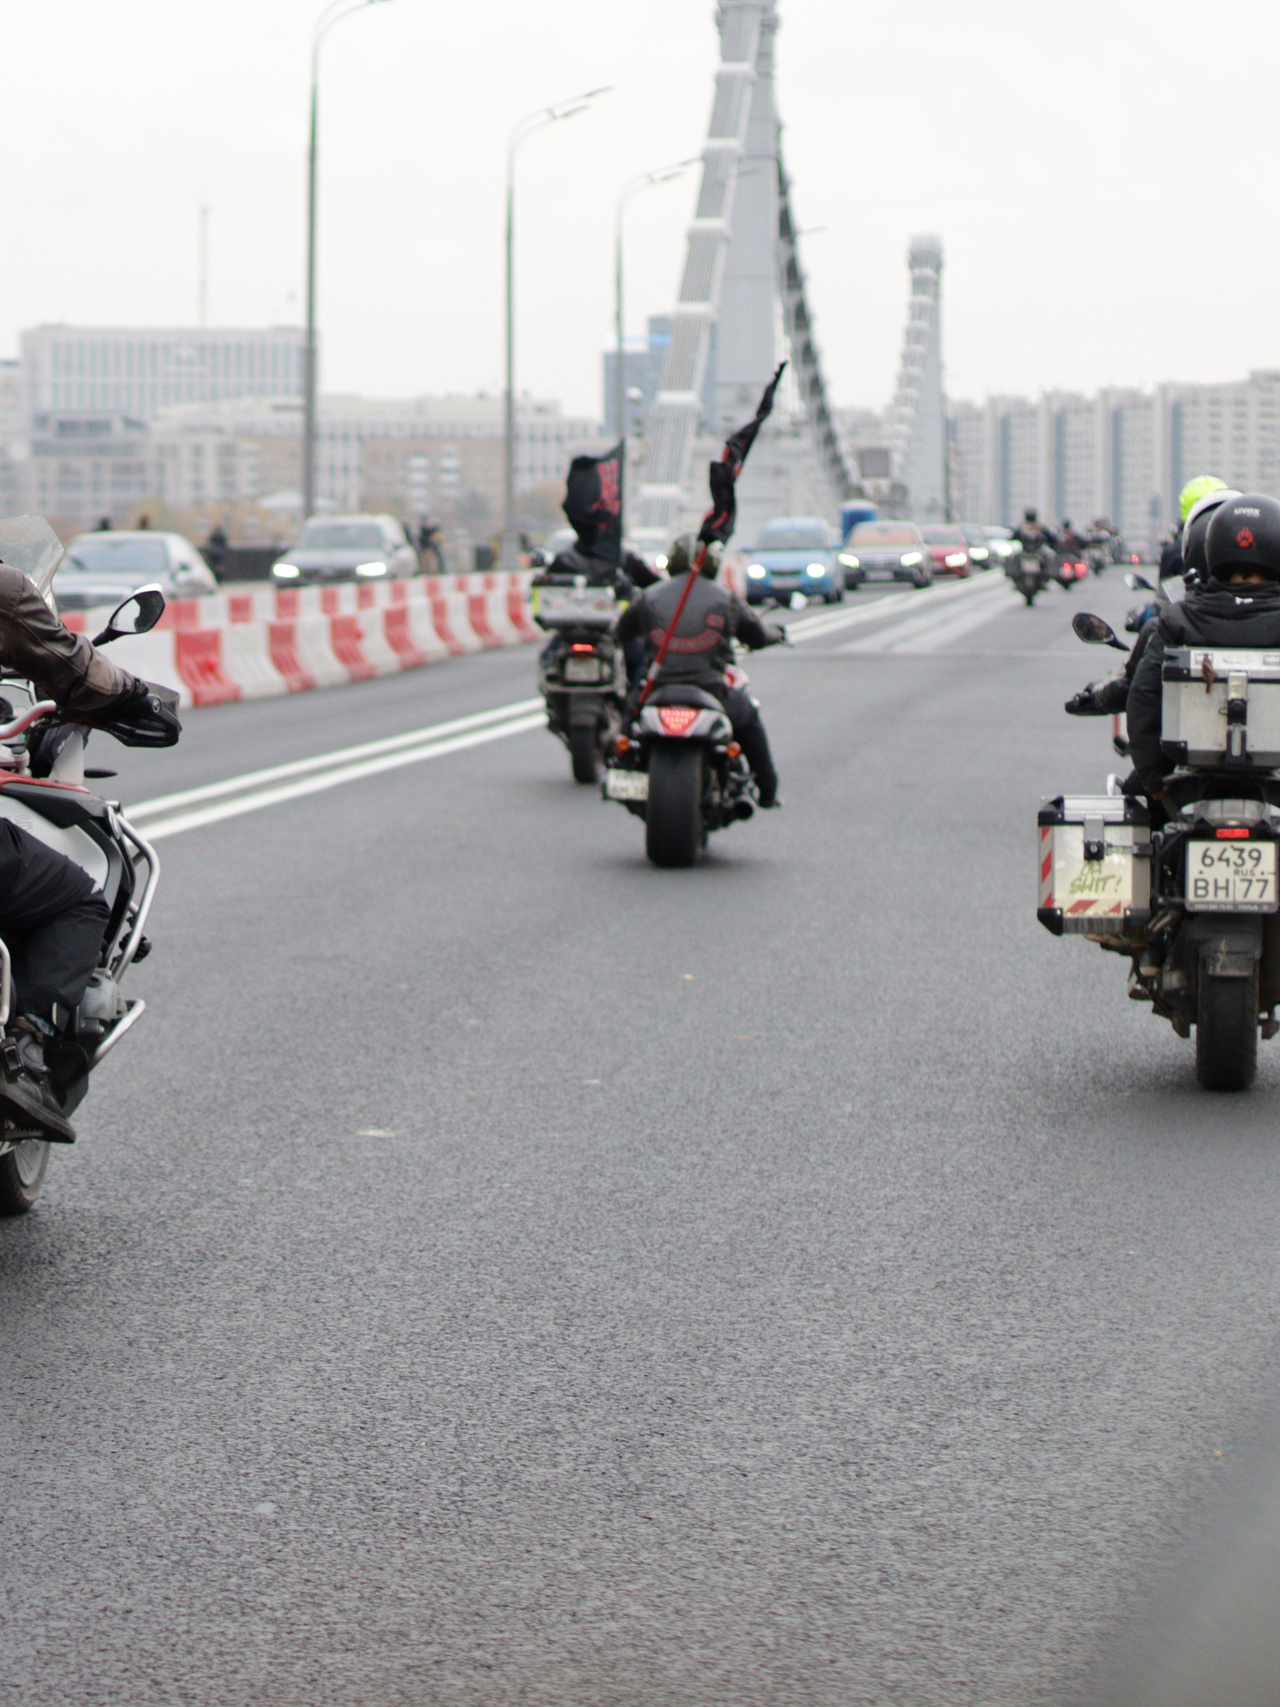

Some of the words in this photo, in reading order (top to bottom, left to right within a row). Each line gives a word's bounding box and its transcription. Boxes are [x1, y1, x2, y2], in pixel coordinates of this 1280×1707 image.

[1201, 845, 1262, 868] 6439
[1194, 878, 1229, 898] BH
[1240, 878, 1269, 898] 77
